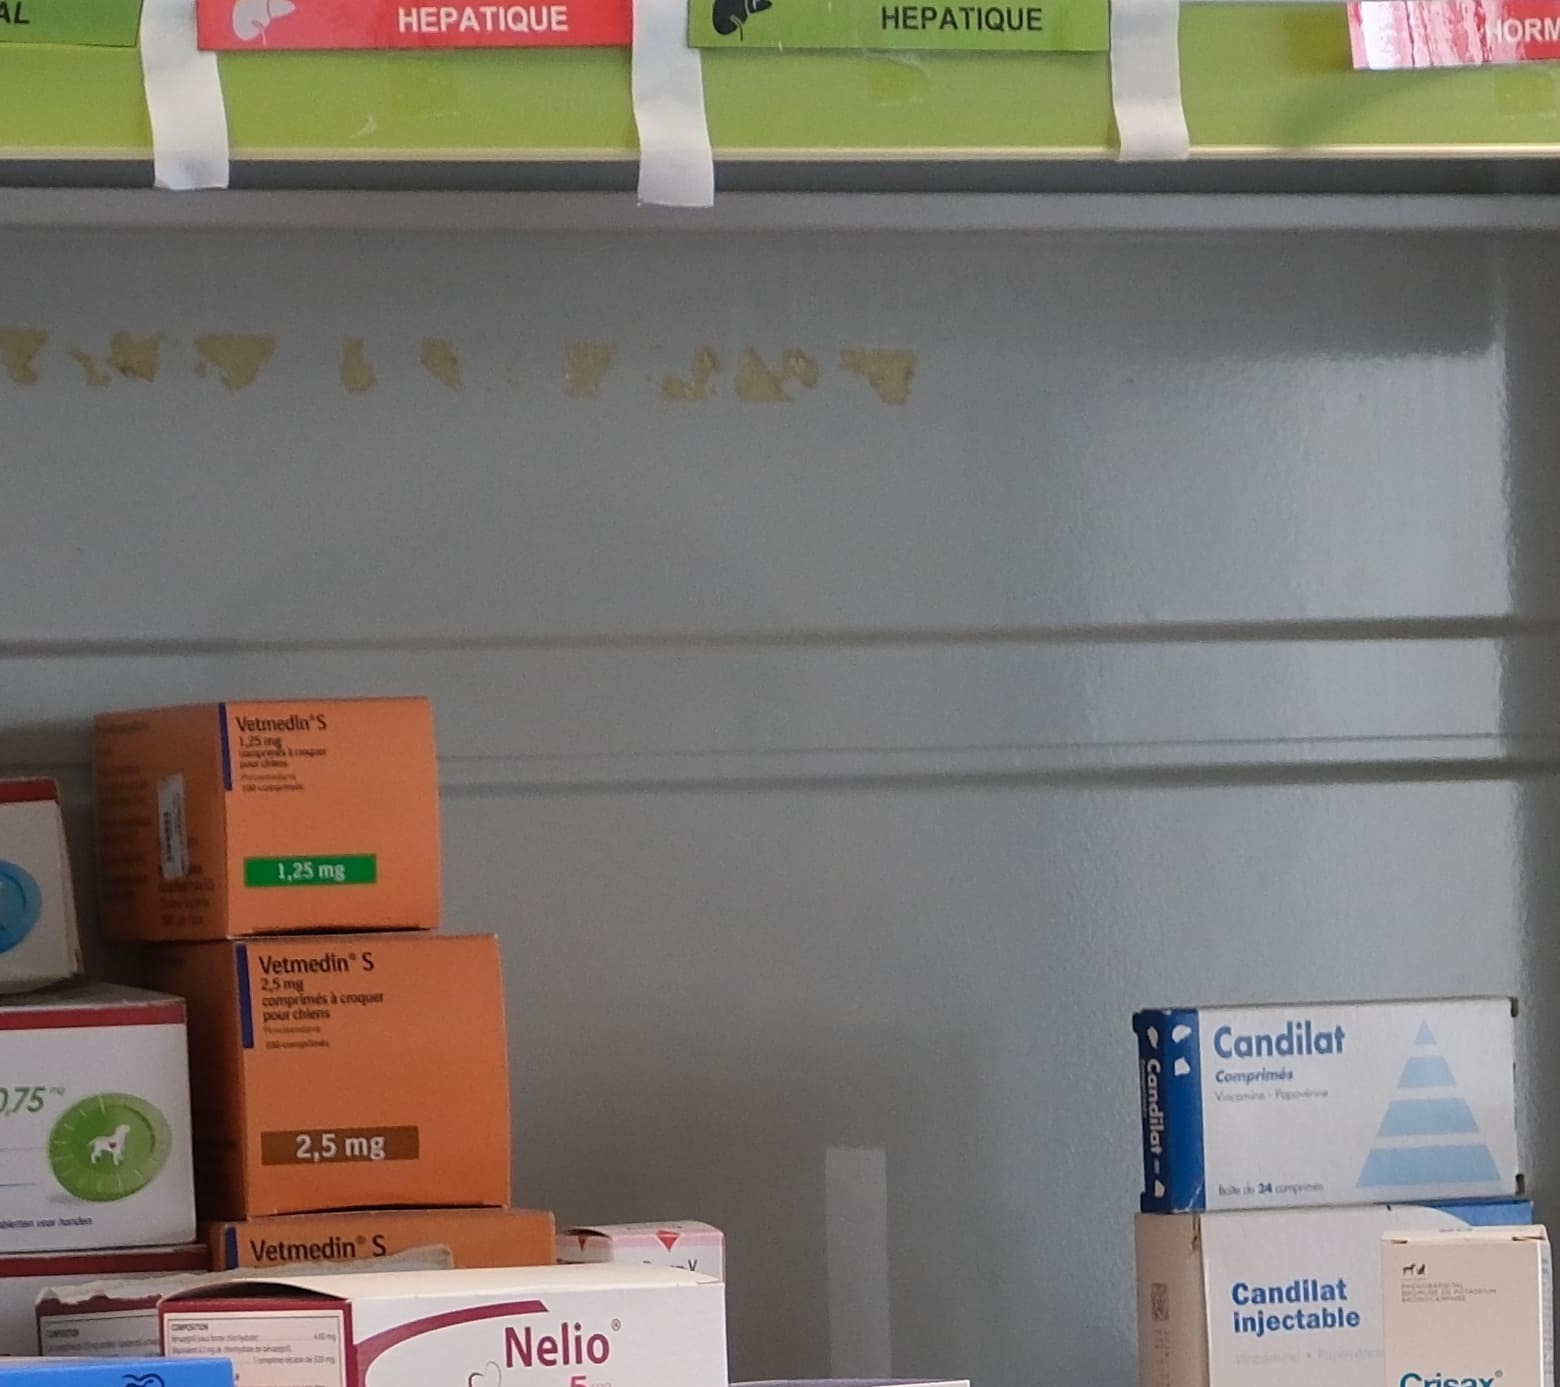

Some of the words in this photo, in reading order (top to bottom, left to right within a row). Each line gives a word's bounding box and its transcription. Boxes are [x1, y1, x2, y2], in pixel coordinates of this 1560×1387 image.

[396, 5, 569, 35] HEPATIQUE
[879, 4, 1044, 34] HEPATIQUE
[236, 714, 310, 733] Vetmedin
[316, 713, 329, 731] S
[277, 862, 314, 883] 1,25
[317, 861, 346, 882] mg
[258, 953, 349, 976] Vetmedin
[362, 951, 376, 973] S
[260, 978, 282, 993] 2,5
[283, 979, 305, 993] mg
[262, 1010, 291, 1023] pour
[292, 1008, 331, 1021] chiens
[1212, 1019, 1346, 1060] Candilat
[1215, 1066, 1295, 1084] Comprimés
[1145, 1057, 1166, 1154] Candilat
[295, 1132, 338, 1162] 2,5
[344, 1134, 386, 1161] mg
[1257, 1182, 1273, 1195] 24
[250, 1236, 357, 1264] Vetmedin
[371, 1234, 388, 1258] S
[1231, 1277, 1348, 1306] Candilat
[1233, 1306, 1361, 1338] injectable
[504, 1321, 611, 1369] Nelio
